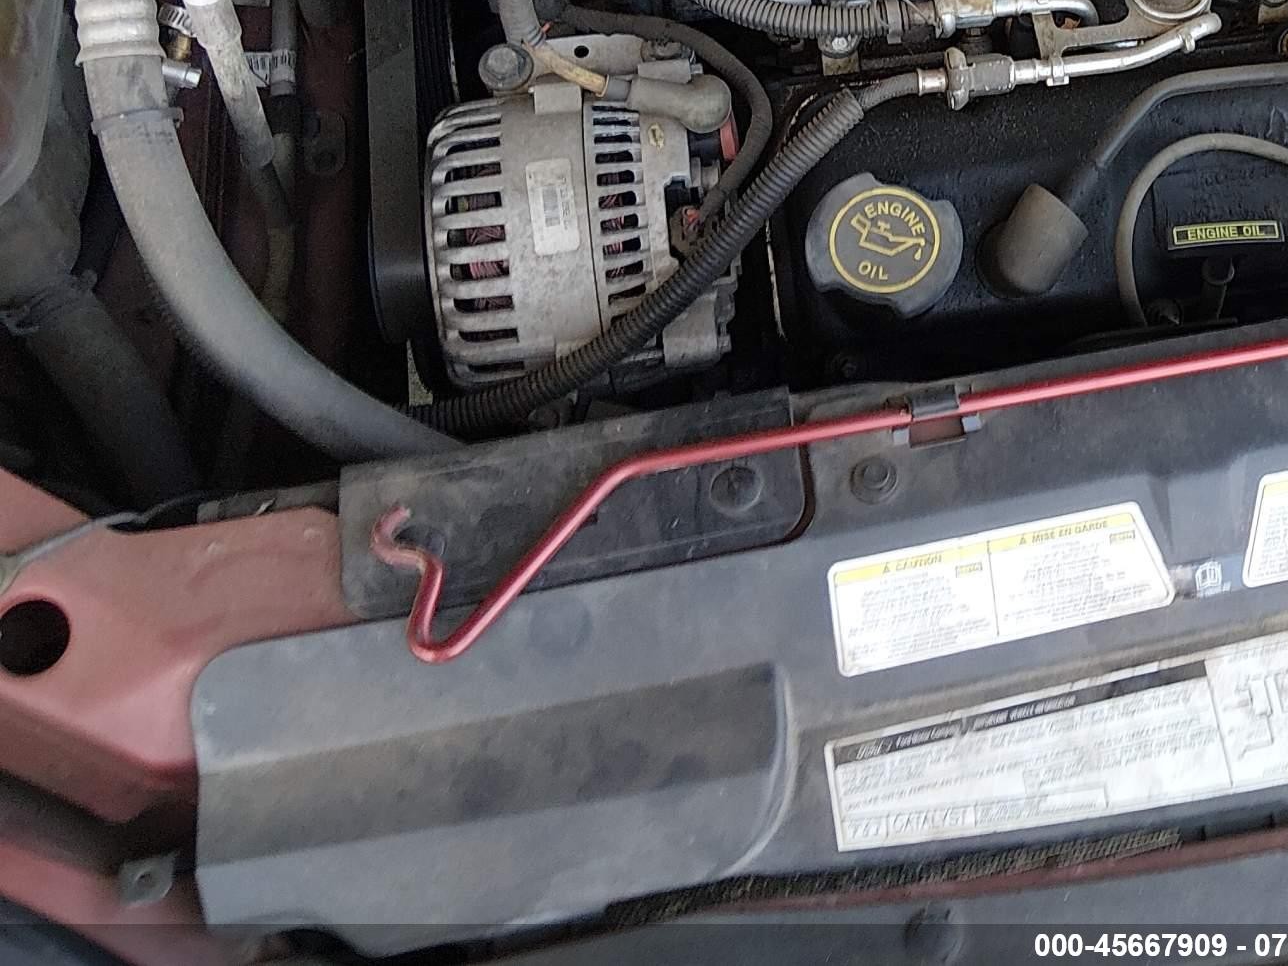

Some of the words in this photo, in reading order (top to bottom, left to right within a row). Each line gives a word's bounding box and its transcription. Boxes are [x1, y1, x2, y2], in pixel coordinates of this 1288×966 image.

[864, 200, 925, 236] ENGINE
[1187, 226, 1239, 241] ENGINE
[1242, 225, 1265, 237] OIL
[858, 260, 888, 280] OIL
[1031, 531, 1055, 545] MISE
[1058, 527, 1073, 539] EN
[1074, 520, 1109, 537] GARDE
[896, 553, 942, 573] CAUTION
[894, 807, 967, 834] CATALYST
